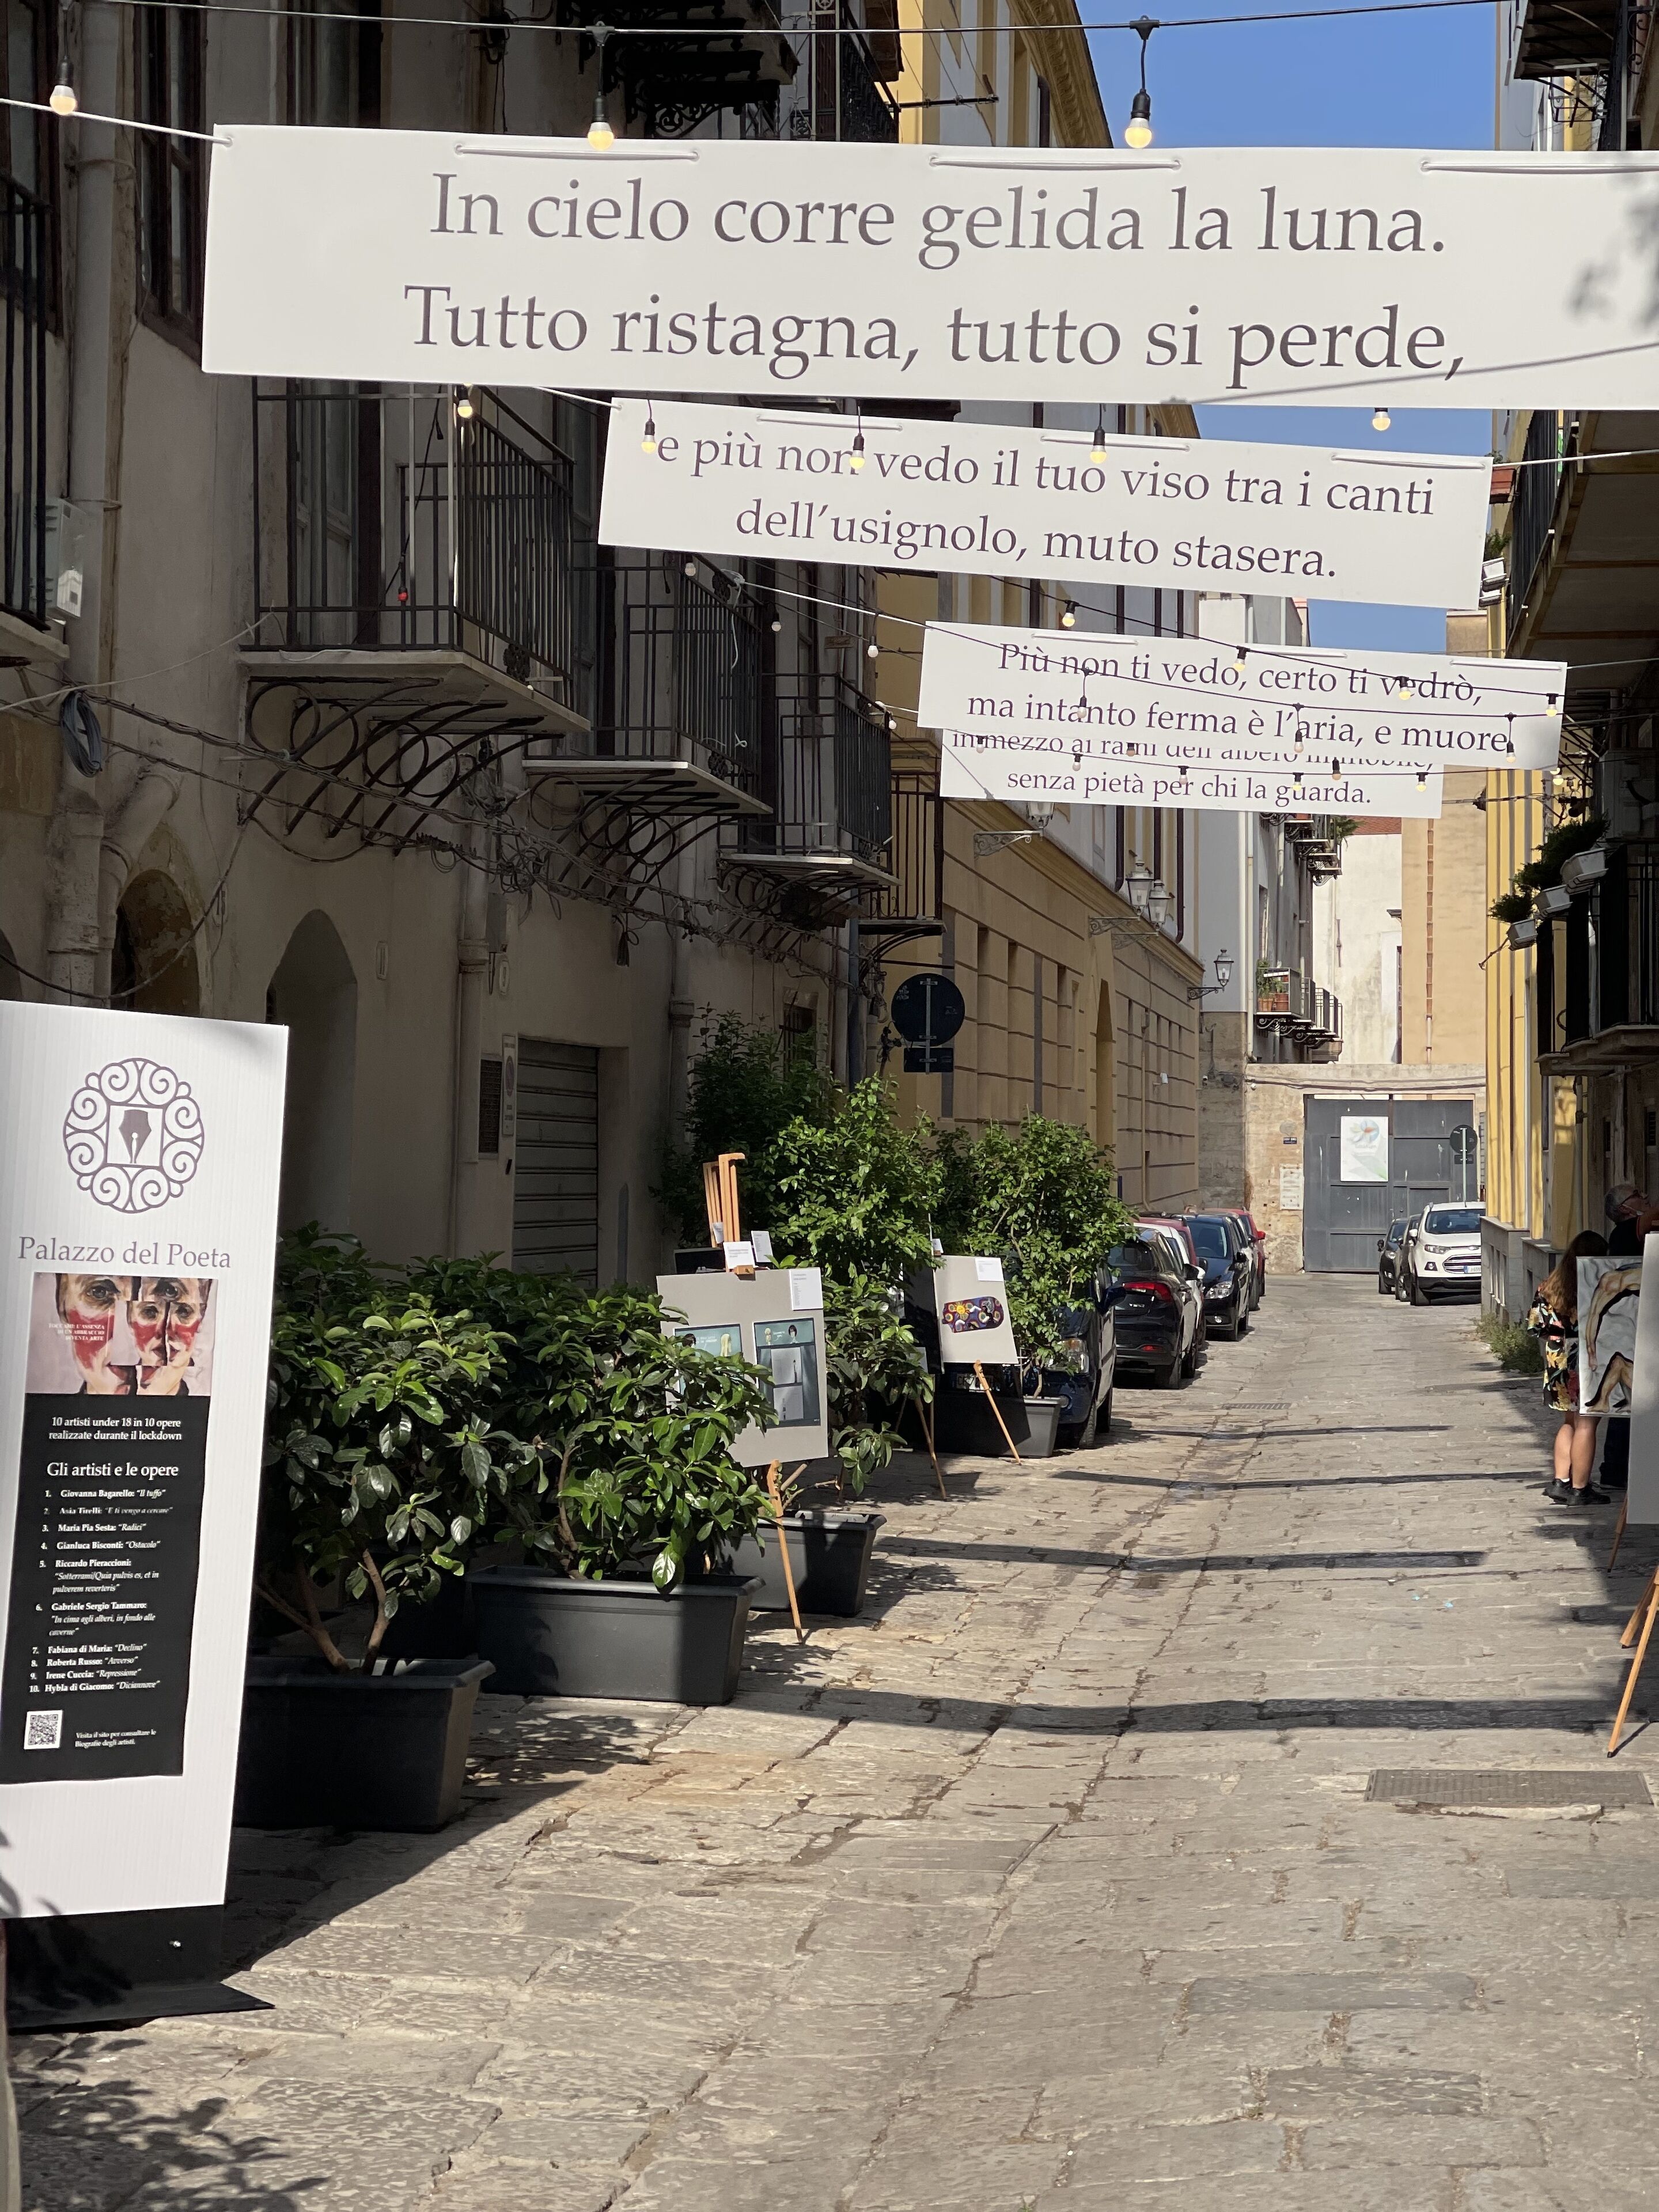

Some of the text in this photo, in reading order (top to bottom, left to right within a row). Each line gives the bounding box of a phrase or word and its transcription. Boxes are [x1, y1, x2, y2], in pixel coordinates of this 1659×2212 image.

[430, 173, 1443, 270] In cielo corre gelida la luna.
[405, 285, 1464, 389] Tutto ristagna, tutto si perde,
[658, 431, 1433, 514] e più non vedo il tuo viso tra i canti
[736, 499, 1335, 577] dell’usignolo, muto stasera.
[999, 643, 1049, 672] Più
[1060, 656, 1119, 677] non
[1129, 654, 1150, 681] ti
[1162, 658, 1247, 691] vedo,
[1260, 665, 1339, 691] certo
[1349, 668, 1368, 694] ti
[968, 694, 1507, 752] ma intanto ferma è l’aria, e muore
[952, 729, 976, 747] in
[984, 734, 1063, 752] mezzo
[1008, 772, 1370, 808] senza pietà per chi la guarda.
[17, 1236, 230, 1267] Palazzo del Poeta
[52, 1417, 181, 1430] 10 artisti under 18 in 10 opere
[49, 1430, 182, 1440] realizzate durante il lockdown
[47, 1462, 179, 1480] Gli artisti e le opere
[99, 1489, 135, 1499] Bagarello:
[57, 1541, 90, 1550] Gianluca
[92, 1541, 123, 1549] Bisconti:
[89, 1559, 131, 1567] Pieraccioni:
[51, 1603, 84, 1611] Gabriele
[86, 1603, 109, 1612] Sergio
[111, 1602, 147, 1610] Tammaro:
[63, 1615, 79, 1623] cima
[81, 1614, 93, 1624] agli
[116, 1614, 123, 1622] in
[124, 1614, 142, 1624] fondo
[143, 1613, 156, 1622] alle
[48, 1646, 77, 1654] Fabiana
[79, 1645, 87, 1653] di
[88, 1645, 112, 1653] Maria:
[46, 1658, 76, 1666] Roberta
[78, 1658, 103, 1666] Russo:
[46, 1671, 65, 1679] Irene
[44, 1684, 68, 1694] Hybla
[70, 1683, 77, 1691] di
[102, 1739, 117, 1747] degli
